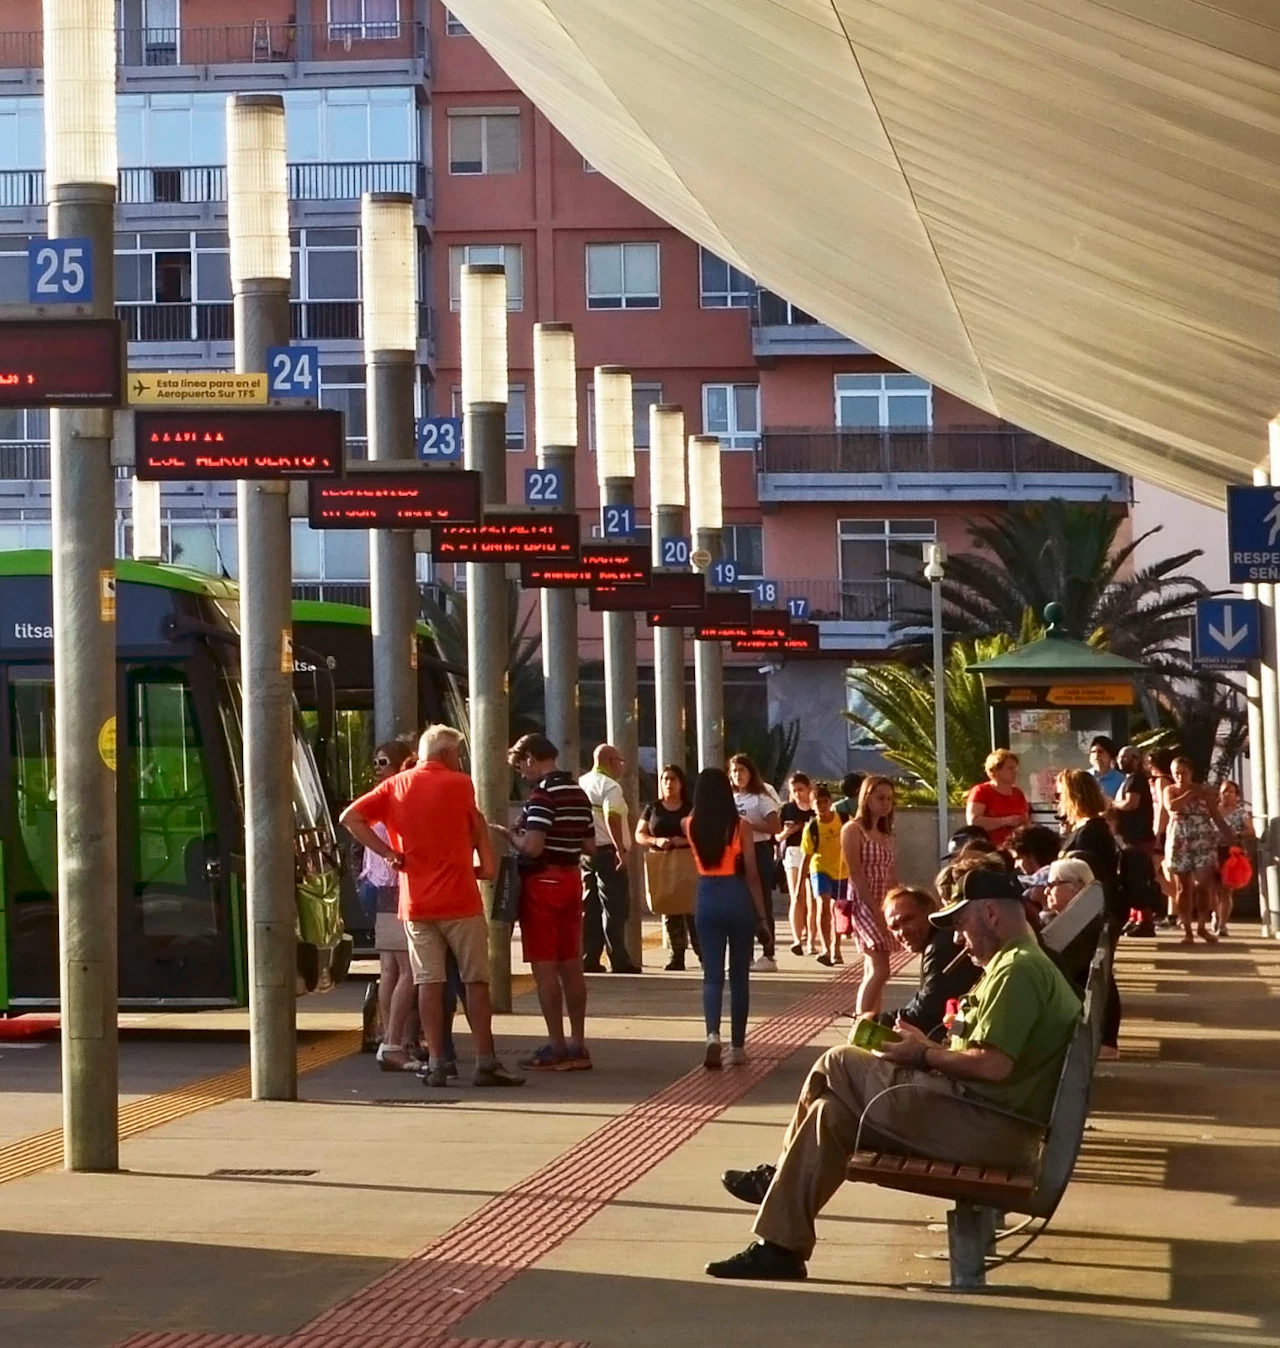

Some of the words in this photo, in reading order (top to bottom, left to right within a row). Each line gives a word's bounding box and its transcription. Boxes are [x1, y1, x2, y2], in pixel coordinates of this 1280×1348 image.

[36, 248, 85, 294] 25
[273, 354, 312, 390] 24
[157, 380, 179, 388] Esta
[209, 381, 234, 391] para
[251, 379, 260, 388] el
[157, 390, 216, 400] Aeropuerto
[217, 390, 235, 398] Sur
[238, 390, 255, 398] TFS
[423, 424, 455, 454] 23
[529, 474, 557, 499] 22
[607, 510, 630, 532] 21
[664, 542, 687, 562] 20
[715, 564, 735, 583] 19
[1249, 565, 1280, 580] SEÑ
[757, 584, 775, 601] 18
[789, 600, 805, 616] 17
[15, 623, 53, 639] titsa
